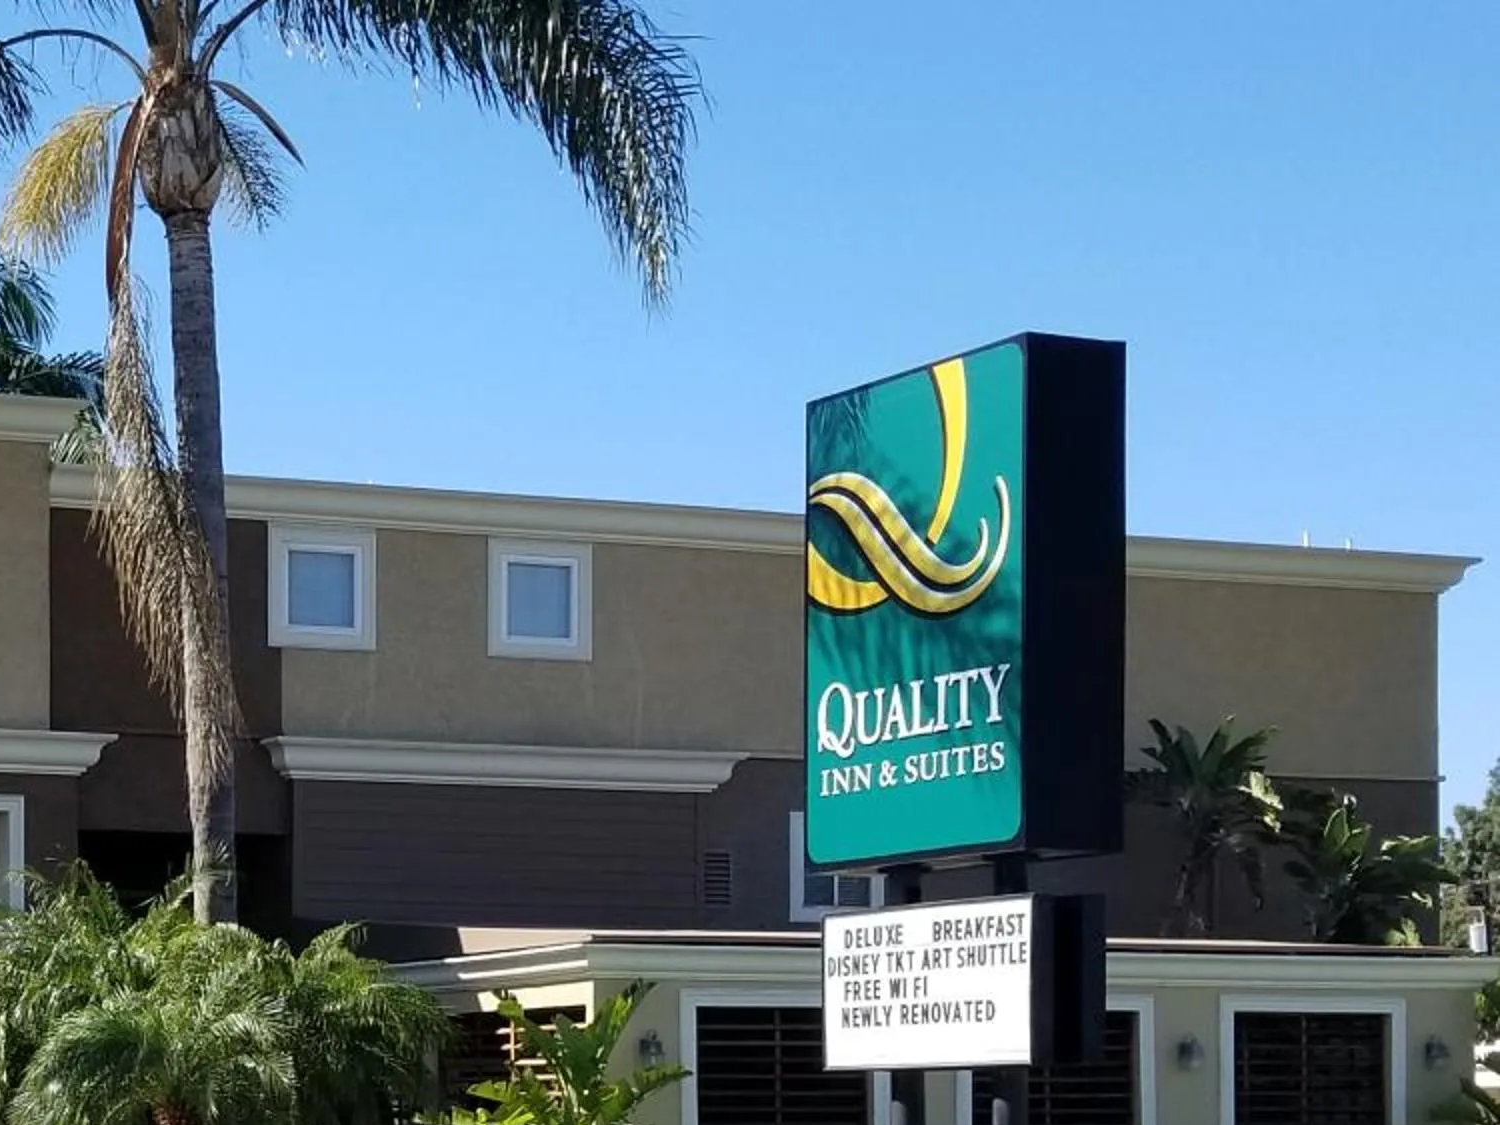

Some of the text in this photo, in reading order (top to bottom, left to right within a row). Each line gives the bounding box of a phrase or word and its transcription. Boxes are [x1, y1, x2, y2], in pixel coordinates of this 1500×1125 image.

[817, 663, 1011, 758] QUALITY
[820, 741, 1006, 797] INN & SUITES
[844, 913, 1026, 949] DELUXE BREAKFAST
[828, 941, 1027, 978] DISNEY TKT ART SHUTTLE
[844, 979, 881, 1002] FREE
[842, 999, 996, 1029] NEWLY RENOVATED
